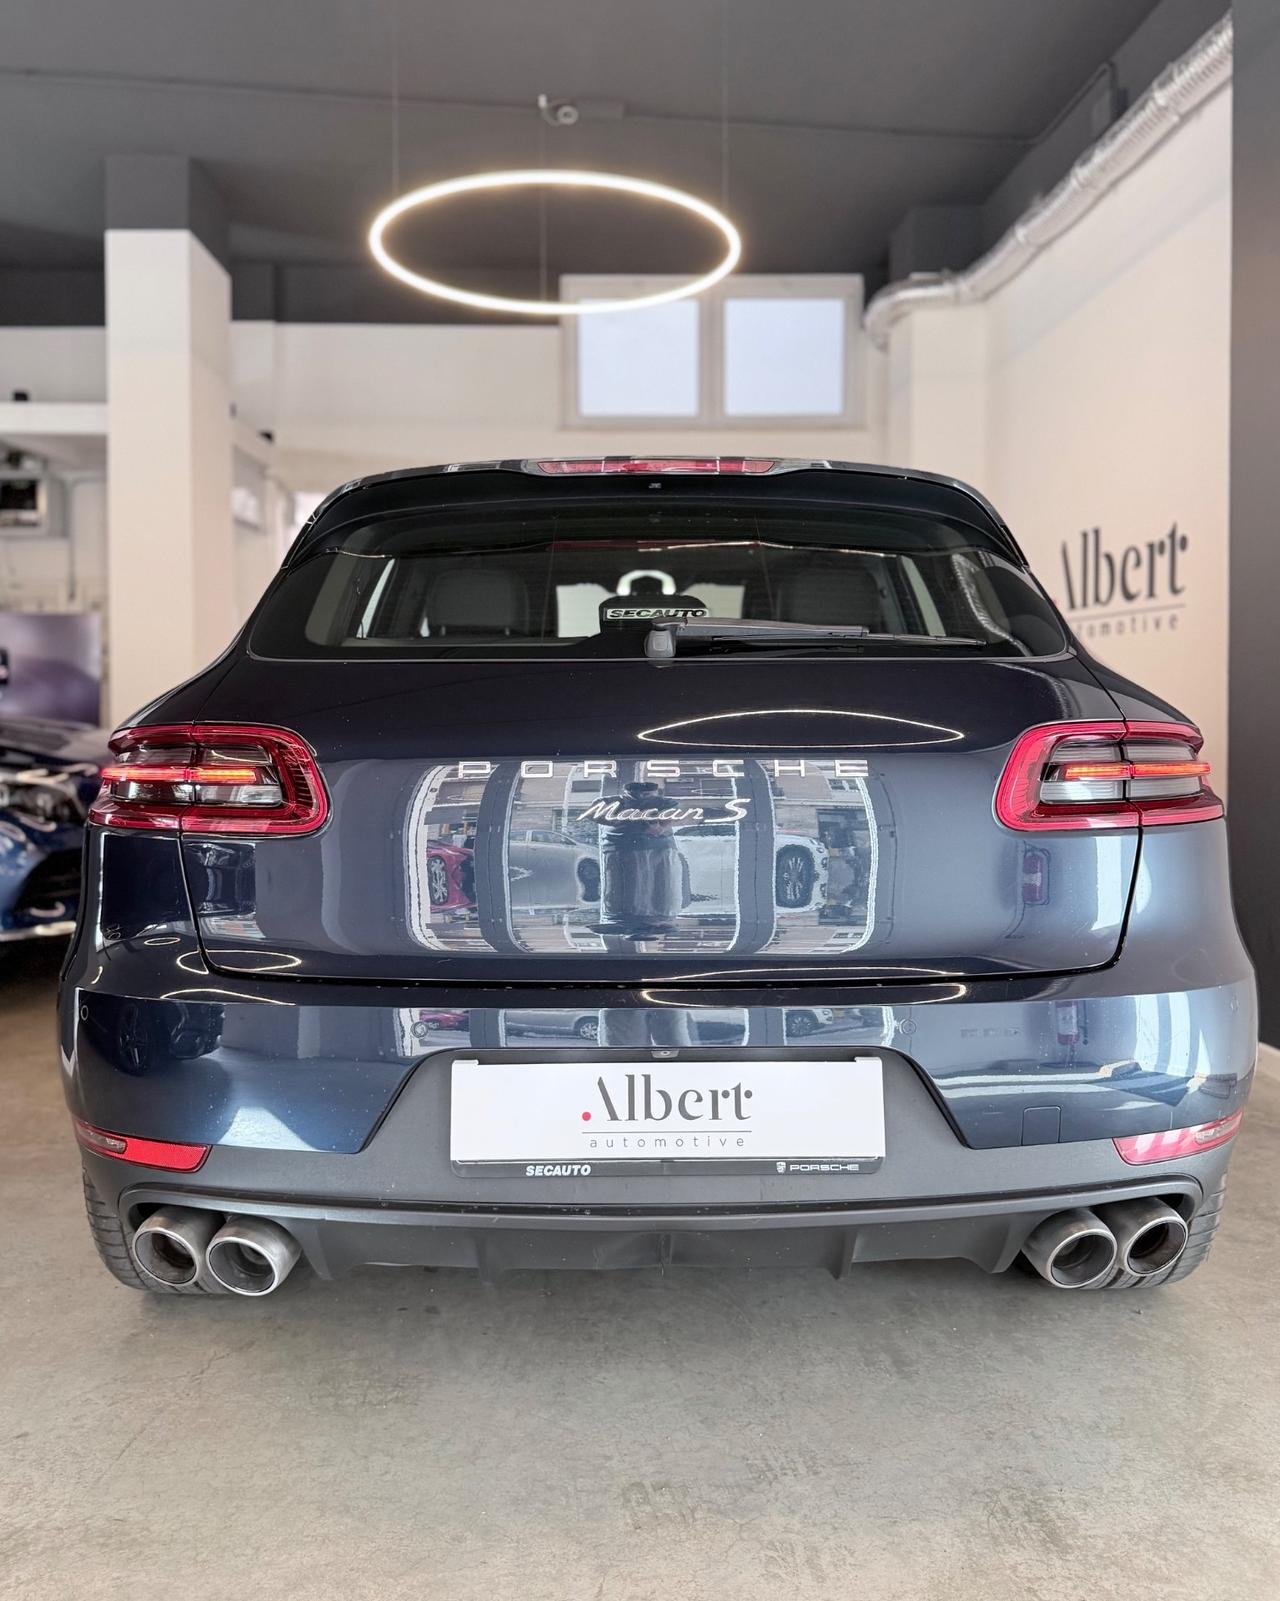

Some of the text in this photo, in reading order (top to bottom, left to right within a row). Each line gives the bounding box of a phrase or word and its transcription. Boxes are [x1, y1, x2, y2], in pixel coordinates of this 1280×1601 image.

[1061, 521, 1188, 610] Albert
[609, 609, 705, 618] SECAUTO
[458, 759, 869, 779] PORSCHE
[576, 798, 751, 823] Macan S
[597, 1074, 753, 1121] Albert
[589, 1135, 745, 1149] automotive
[525, 1164, 592, 1177] SECAUTO
[789, 1164, 860, 1172] PORSCHE
